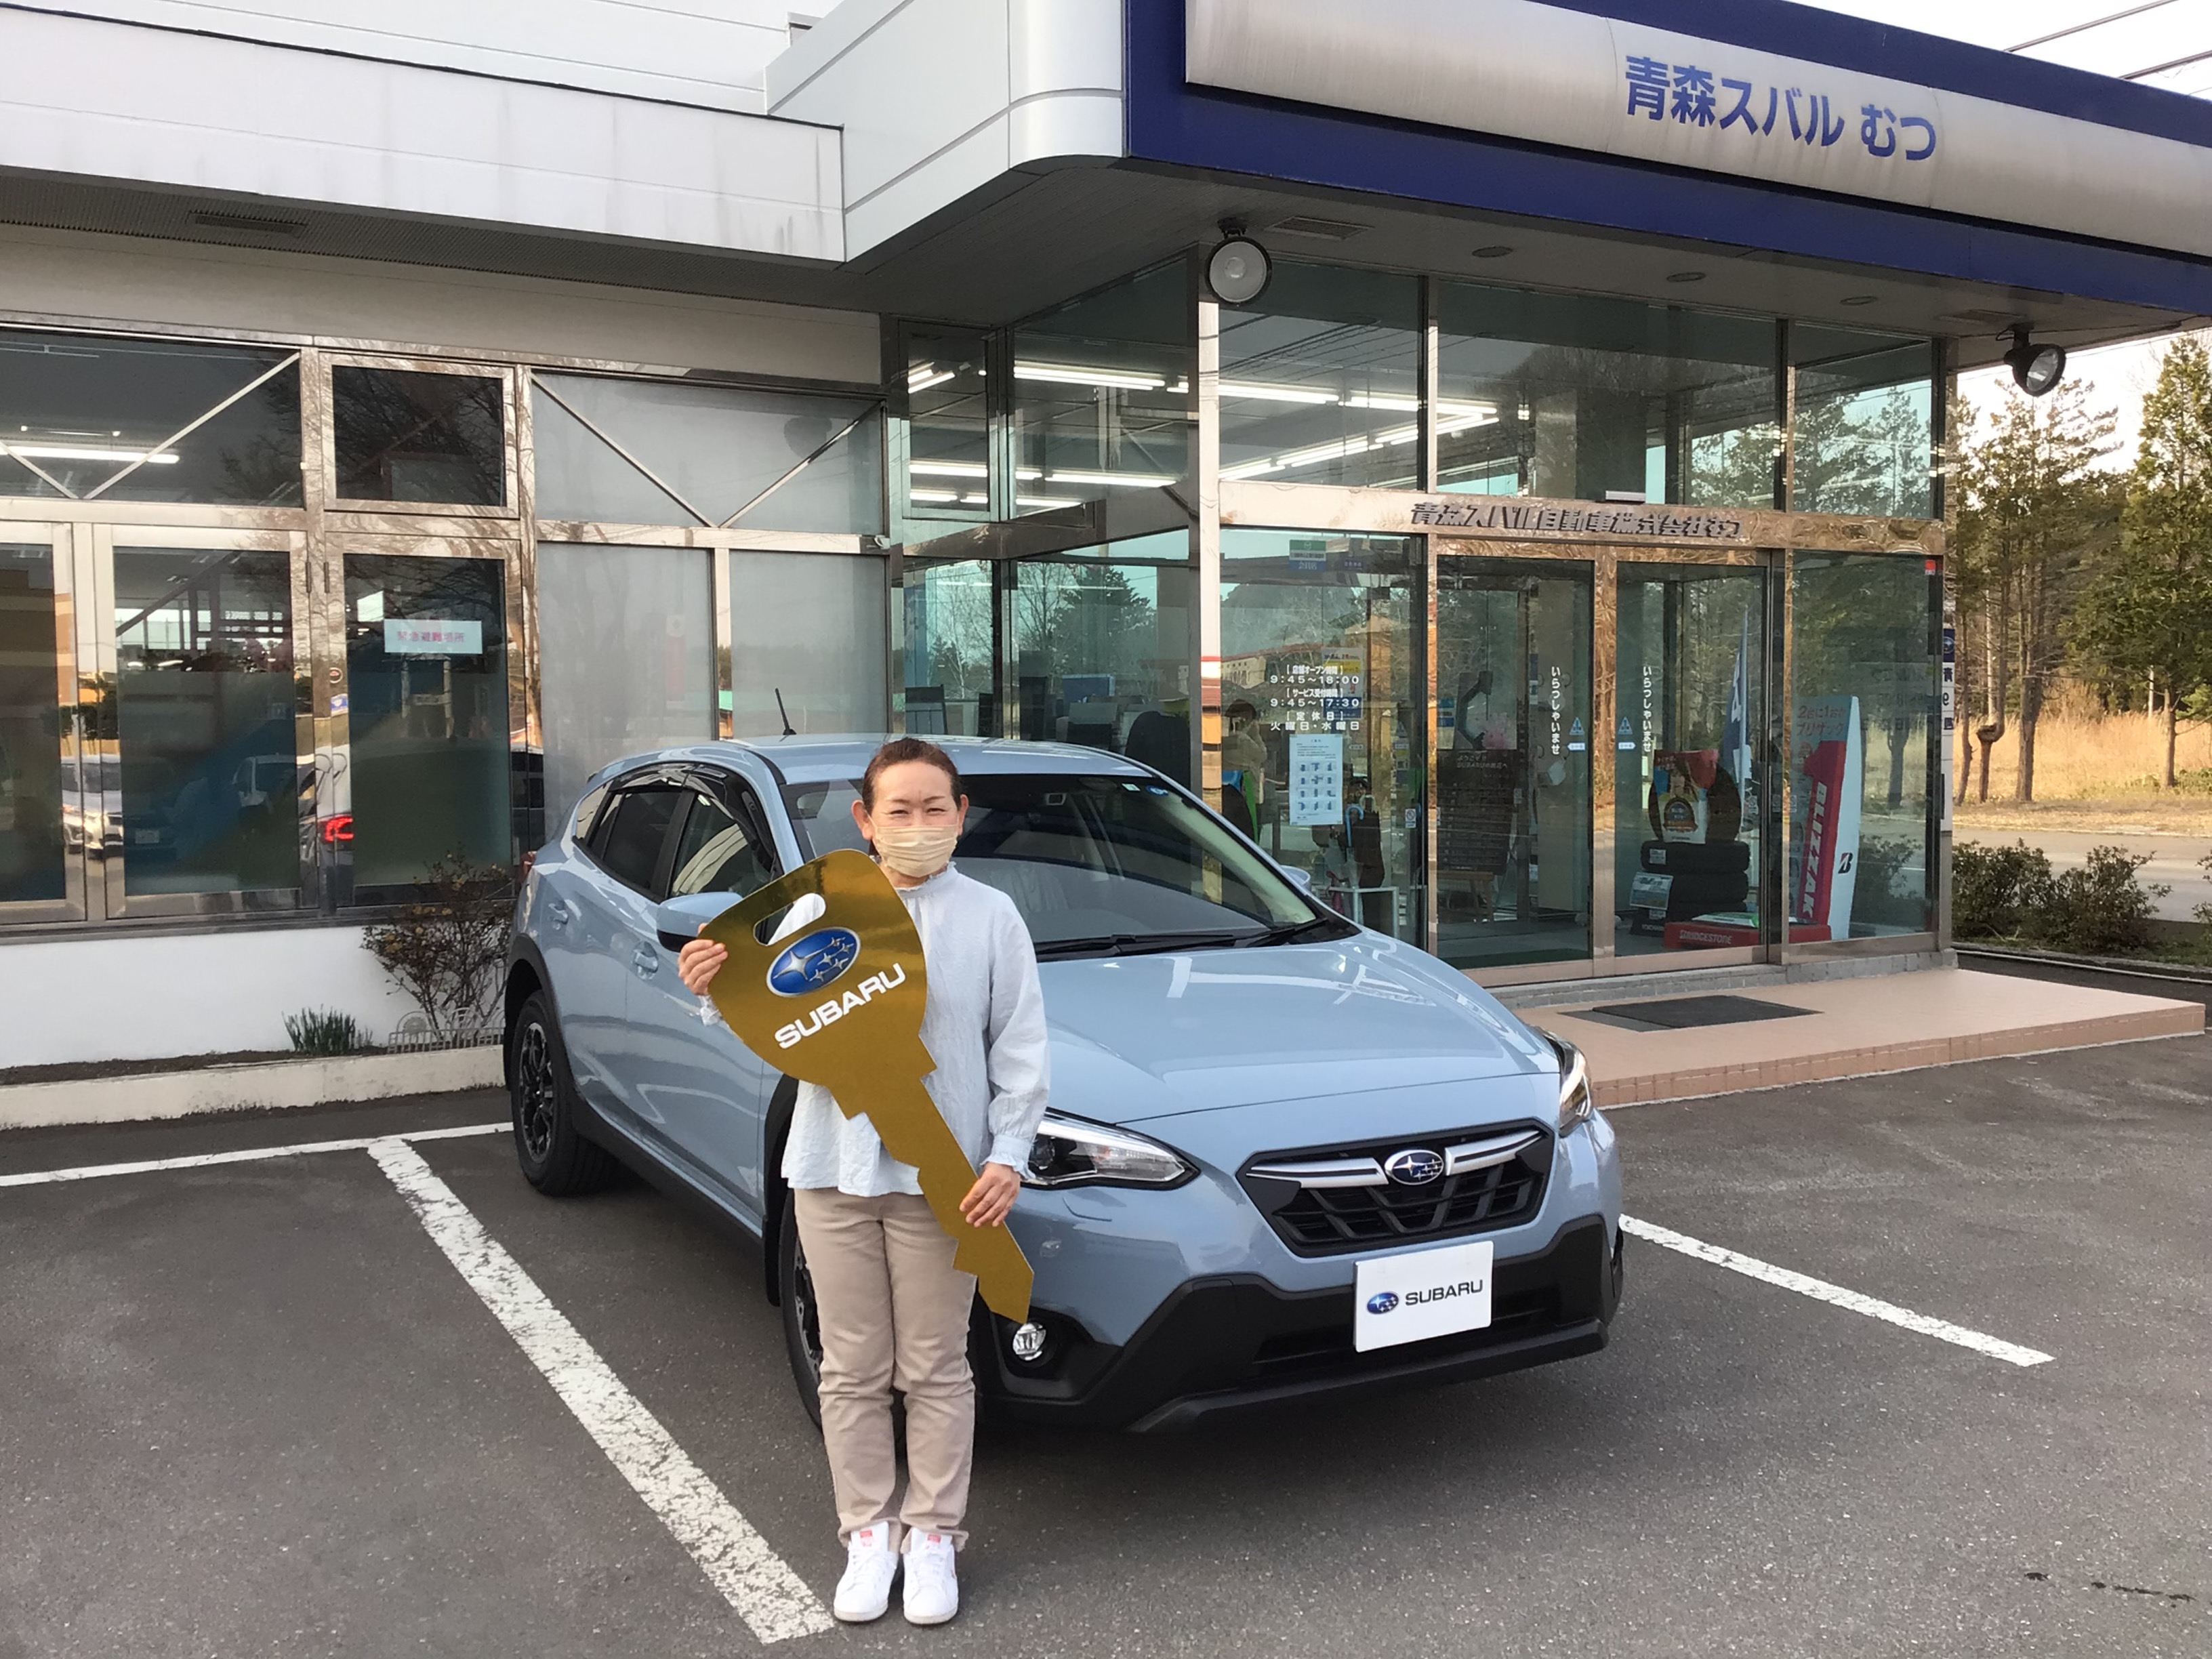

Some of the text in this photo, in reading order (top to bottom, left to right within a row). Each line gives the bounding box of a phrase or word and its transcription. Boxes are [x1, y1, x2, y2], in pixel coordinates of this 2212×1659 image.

[1625, 55, 1937, 161] 青森スバル むつ
[1803, 781, 1827, 918] BLIZZAK
[775, 962, 906, 1049] SUBARU
[1405, 1279, 1483, 1306] SUBARU
